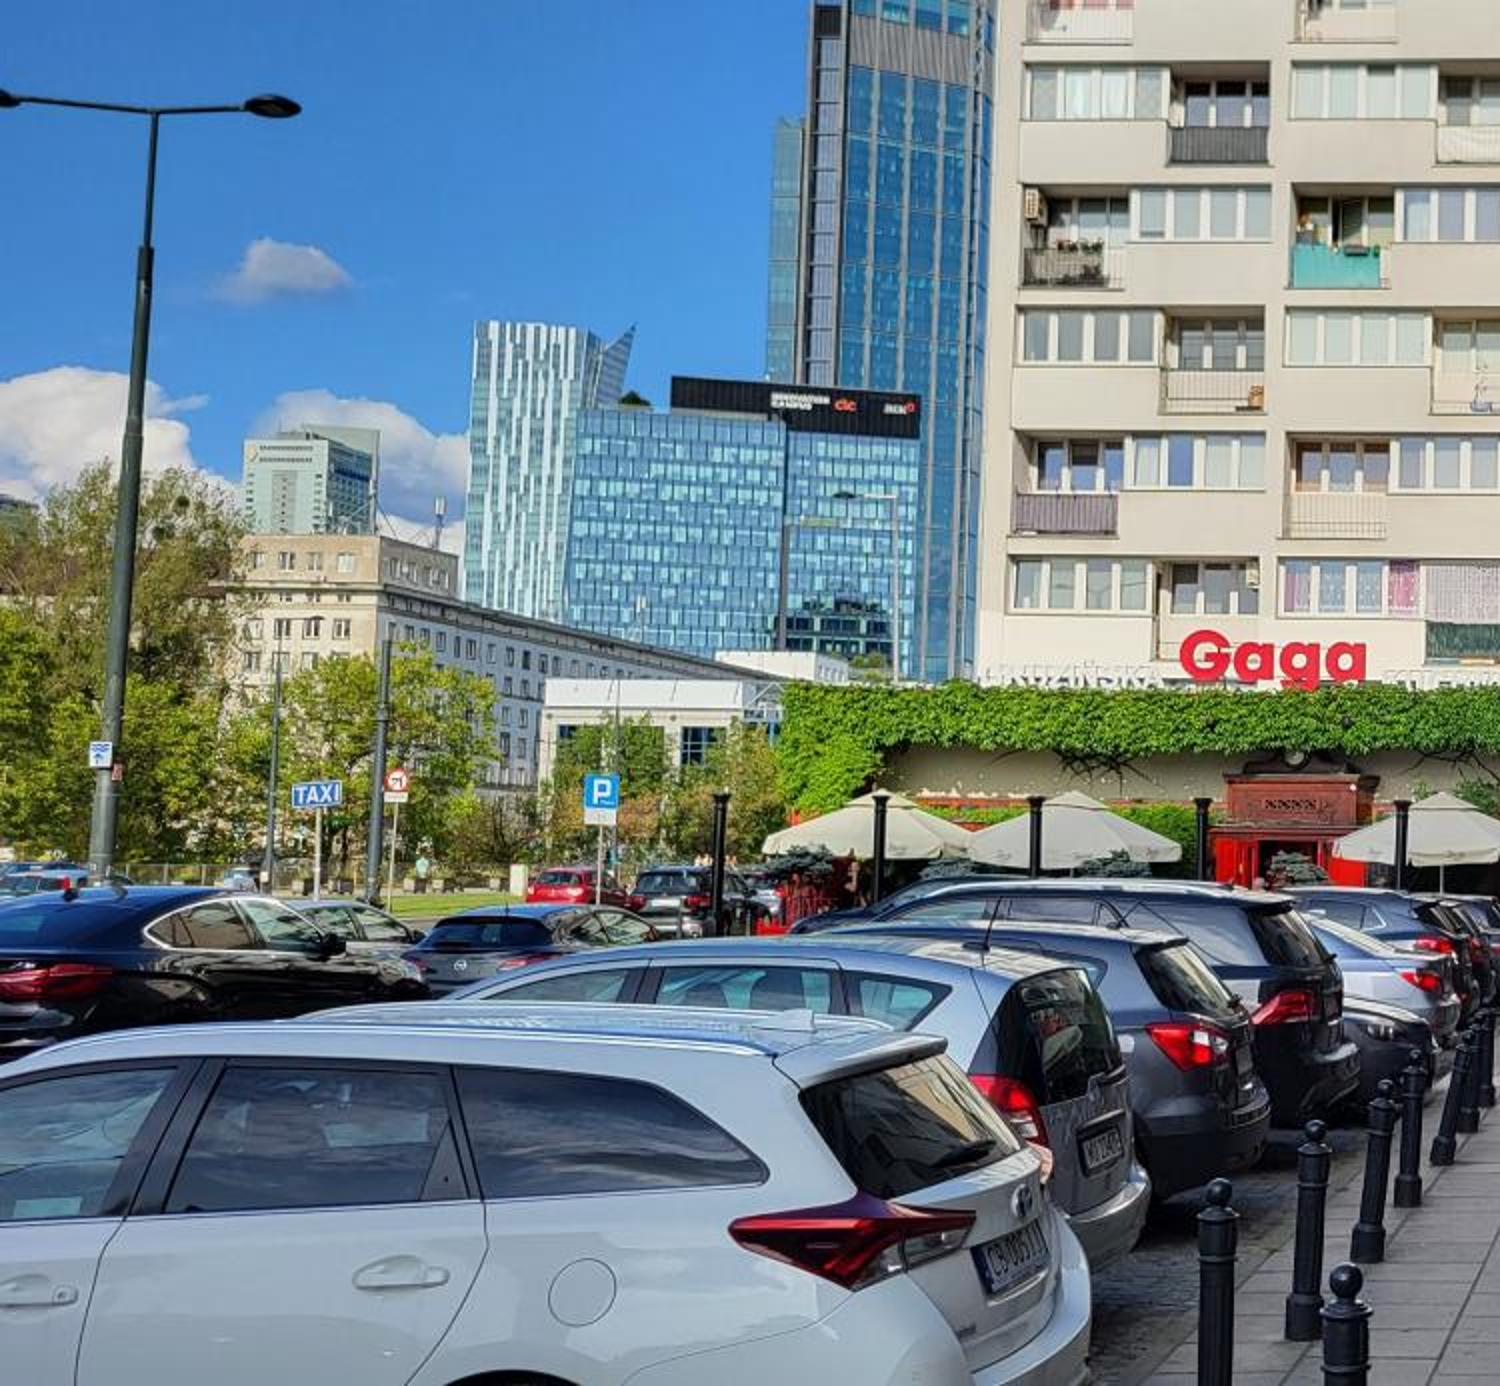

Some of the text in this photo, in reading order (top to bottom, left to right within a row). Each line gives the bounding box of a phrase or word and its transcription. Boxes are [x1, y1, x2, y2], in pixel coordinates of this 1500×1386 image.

[1179, 628, 1367, 691] Gaga
[295, 783, 340, 805] TAXI
[593, 779, 612, 805] P
